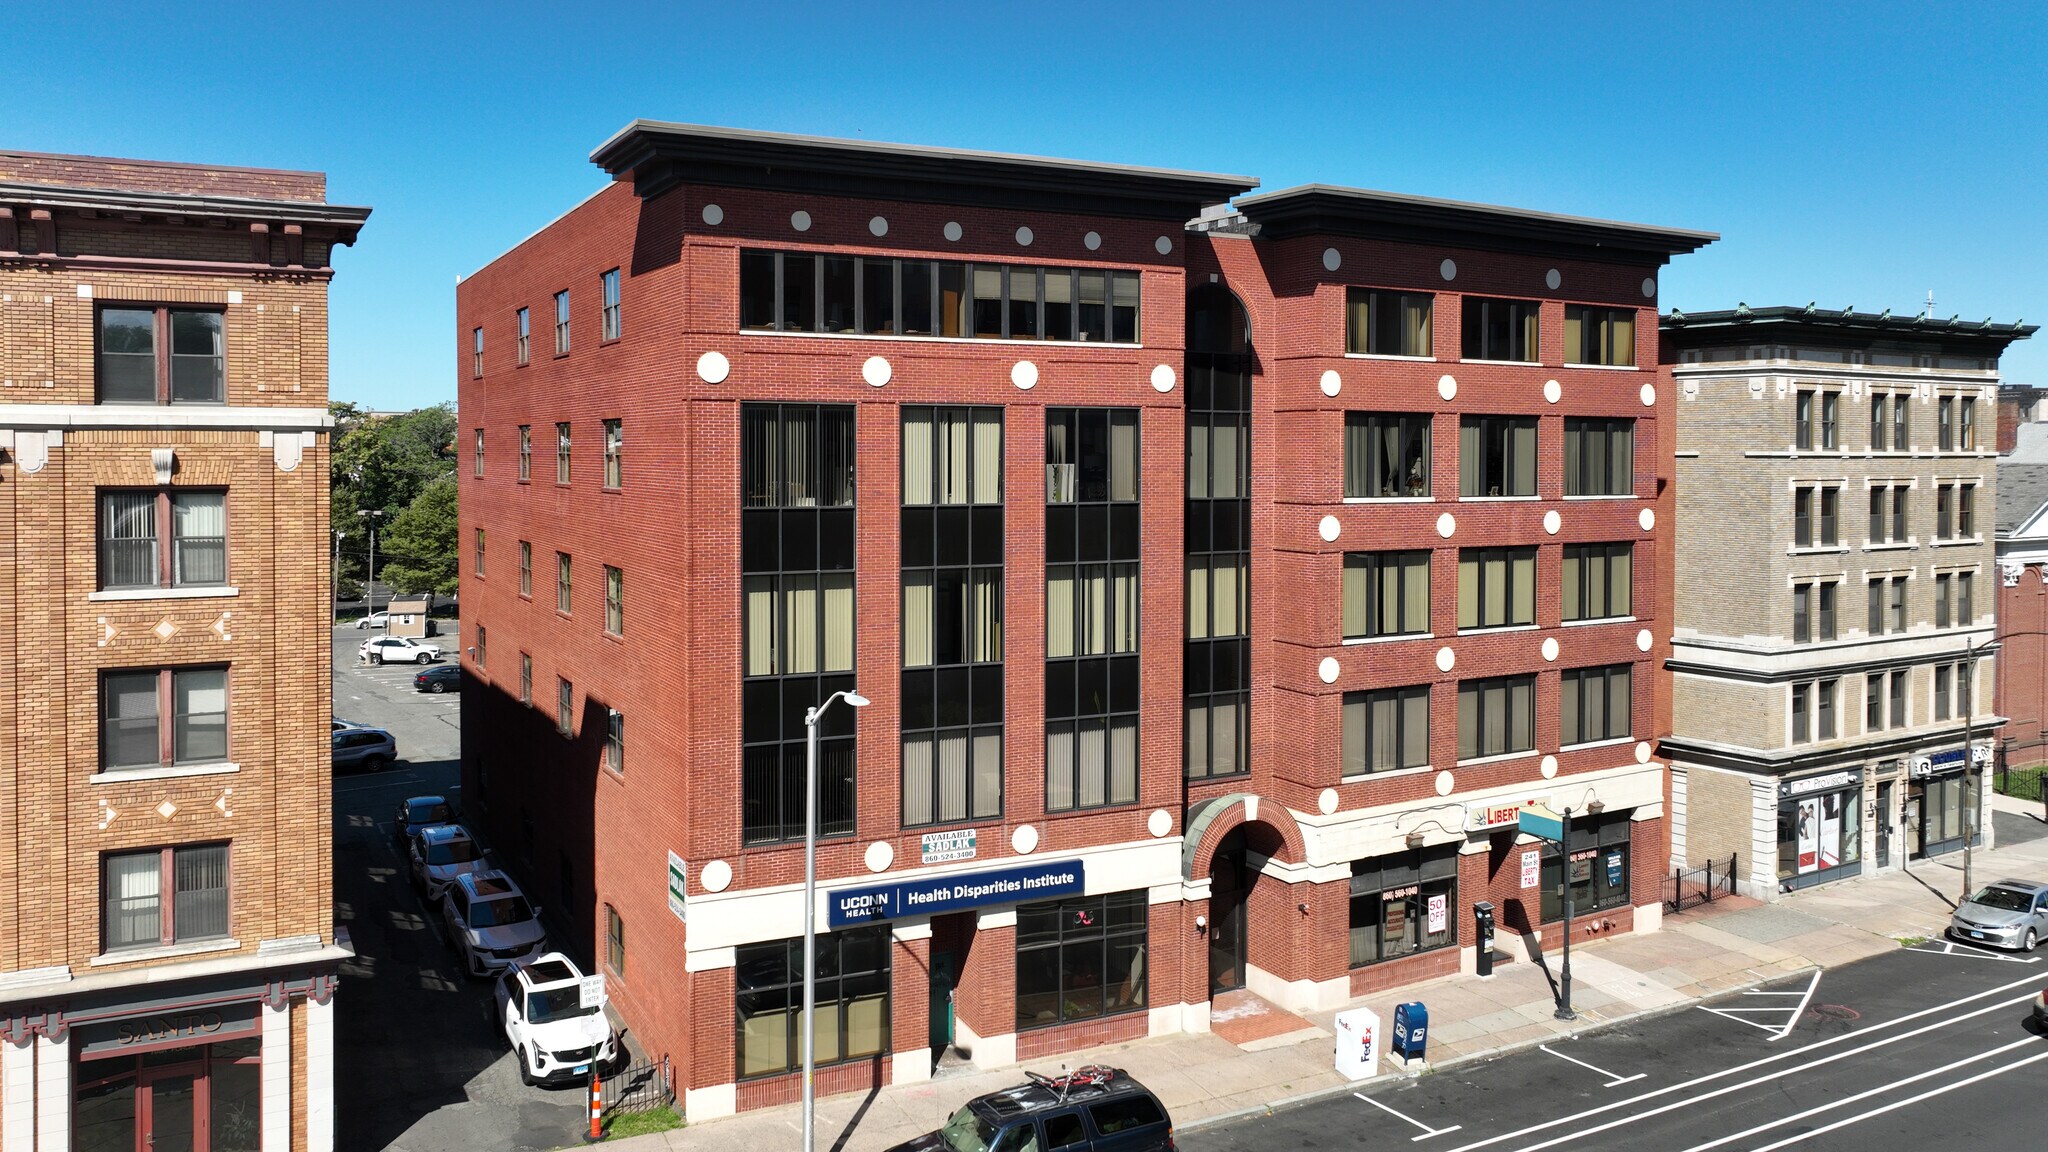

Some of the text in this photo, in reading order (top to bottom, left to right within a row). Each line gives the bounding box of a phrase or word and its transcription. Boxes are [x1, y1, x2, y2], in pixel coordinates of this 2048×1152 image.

[1813, 775, 1847, 789] ProVision
[1487, 807, 1519, 825] LIBERT
[925, 830, 973, 843] AVAILABLE
[928, 838, 970, 853] SADLAK
[925, 850, 974, 862] 860-524-3400
[1522, 867, 1538, 877] LIBERTY
[1524, 877, 1535, 886] TAX
[841, 873, 1075, 910] UCONN Health Disparities Institute
[846, 906, 883, 918] HEALTH
[1429, 911, 1445, 923] OFF
[585, 995, 600, 1004] ENTER
[117, 1012, 222, 1045] SANTO
[1338, 1018, 1351, 1032] FedEx
[1361, 1027, 1372, 1063] FedEx
